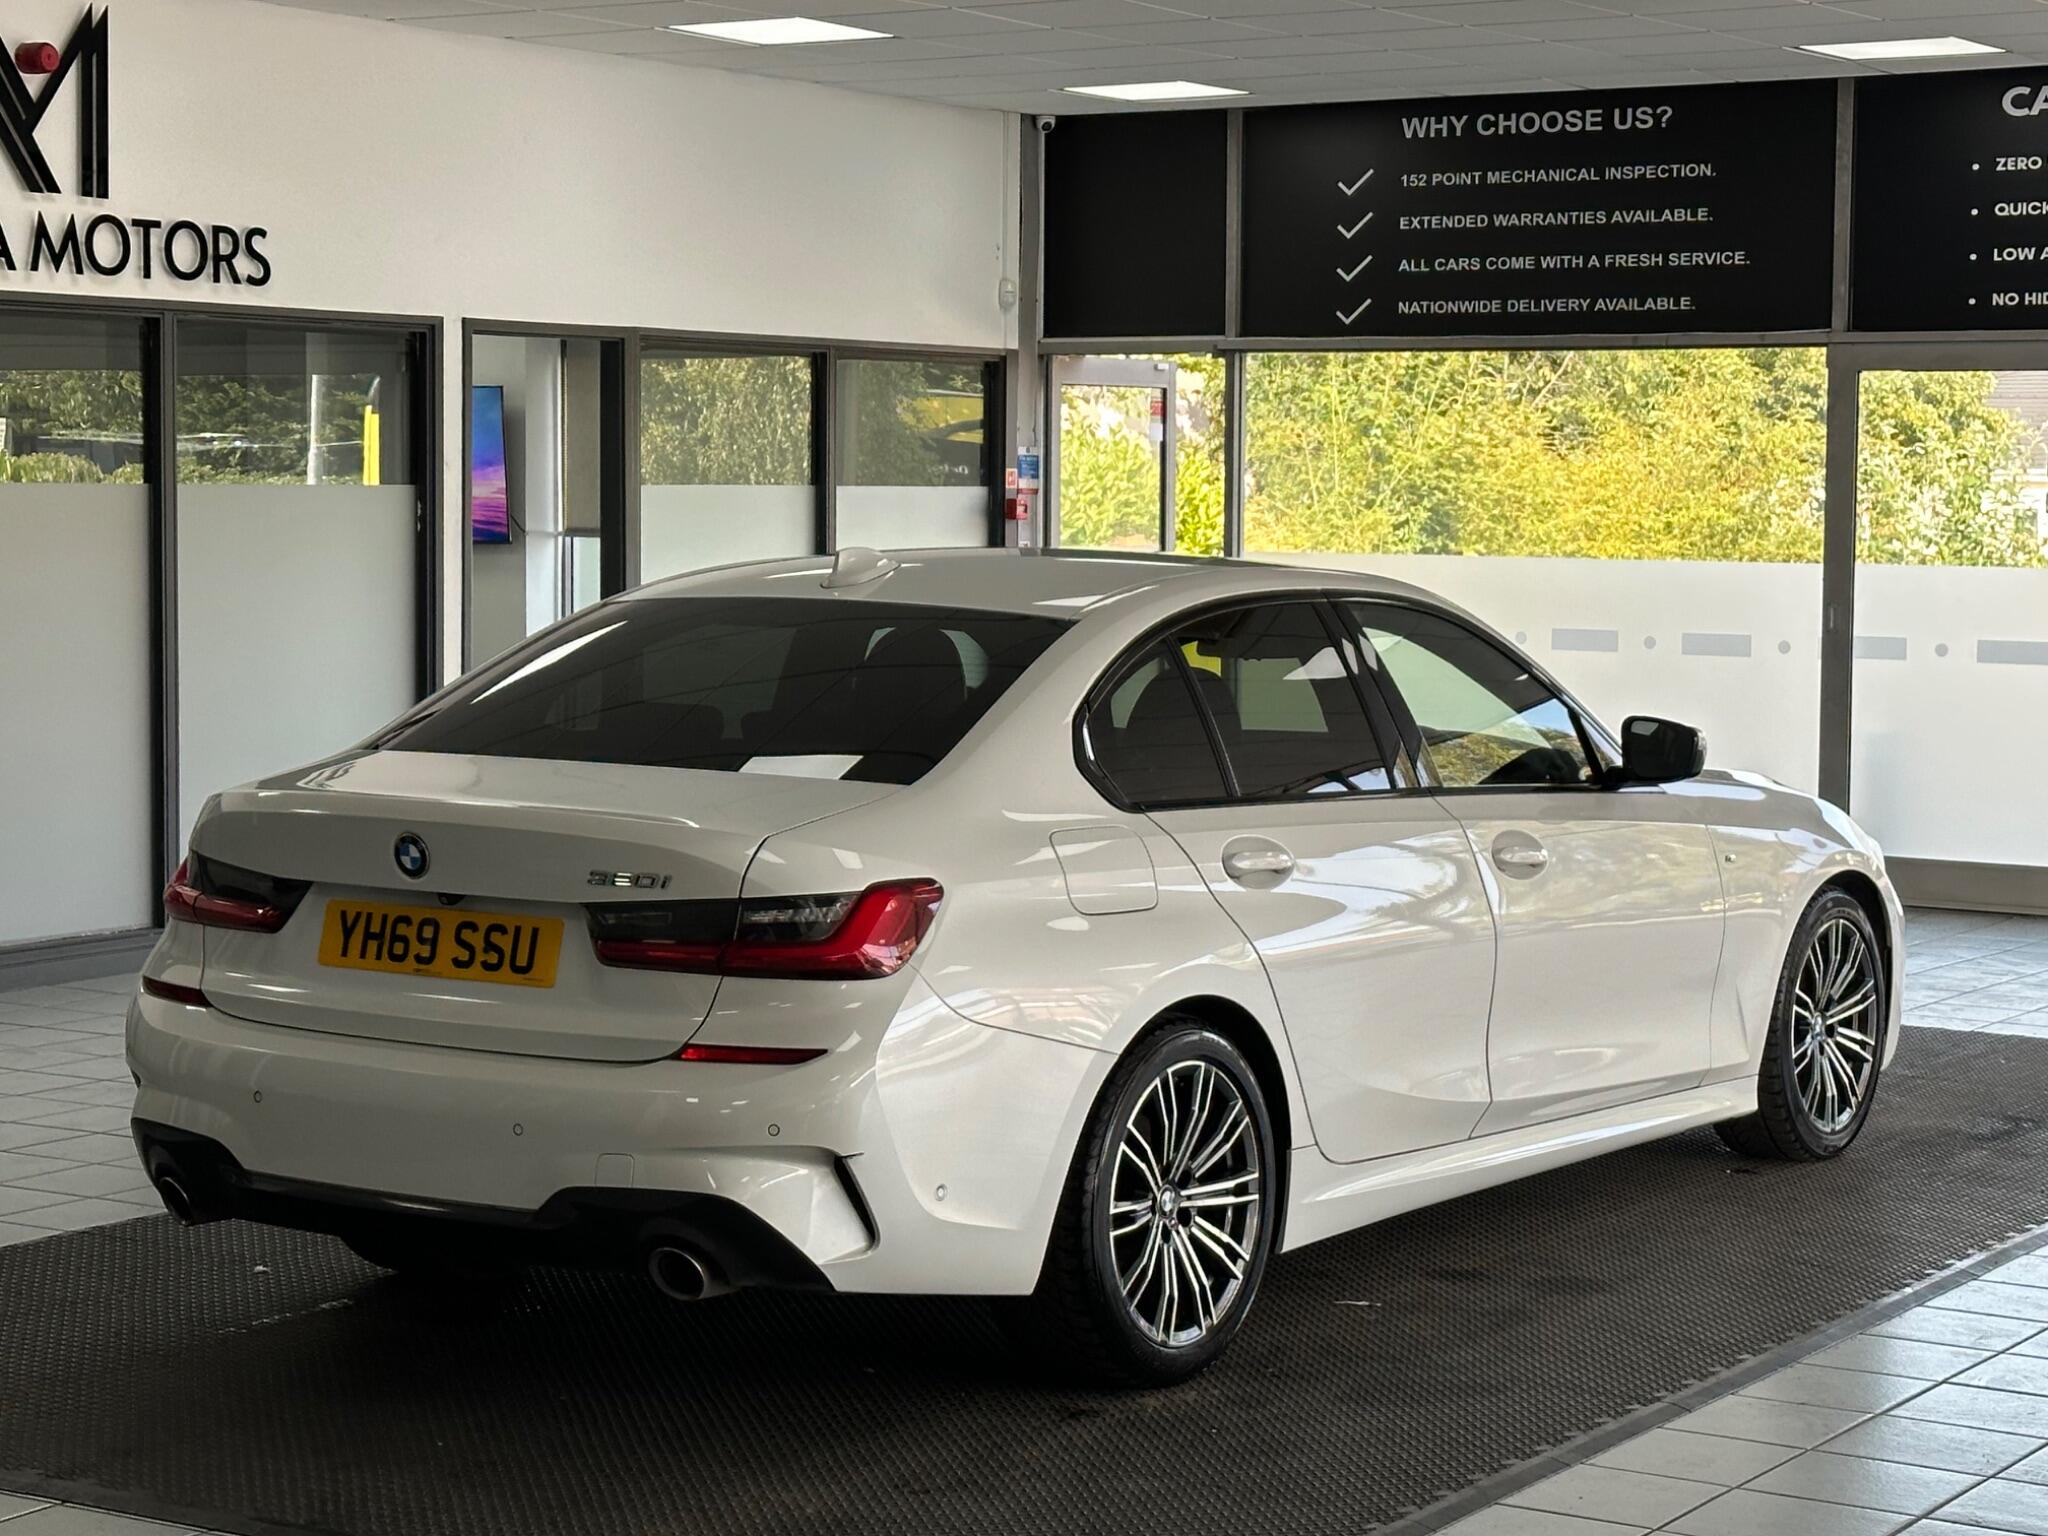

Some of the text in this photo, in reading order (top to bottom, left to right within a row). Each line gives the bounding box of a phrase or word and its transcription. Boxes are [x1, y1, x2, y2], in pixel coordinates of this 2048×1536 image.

[2001, 85, 2048, 117] CA
[1402, 106, 1673, 139] WHY CHOOSE US?
[1400, 163, 1717, 187] 152 POINT MECHANICAL INSPECTION.
[1995, 156, 2043, 171] ZERO
[1400, 207, 1713, 230] EXTENDED WARRANTIES AVAILABLE.
[30, 210, 272, 287] MOTORS
[1993, 247, 2036, 261] LOW
[1398, 251, 1750, 272] ALL CARS COME WITH A FRESH SERVICE.
[1398, 296, 1697, 314] NATIONWIDE DELIVERY AVAILABLE.
[1992, 292, 2020, 306] NO
[339, 909, 541, 975] YH69 SSU
